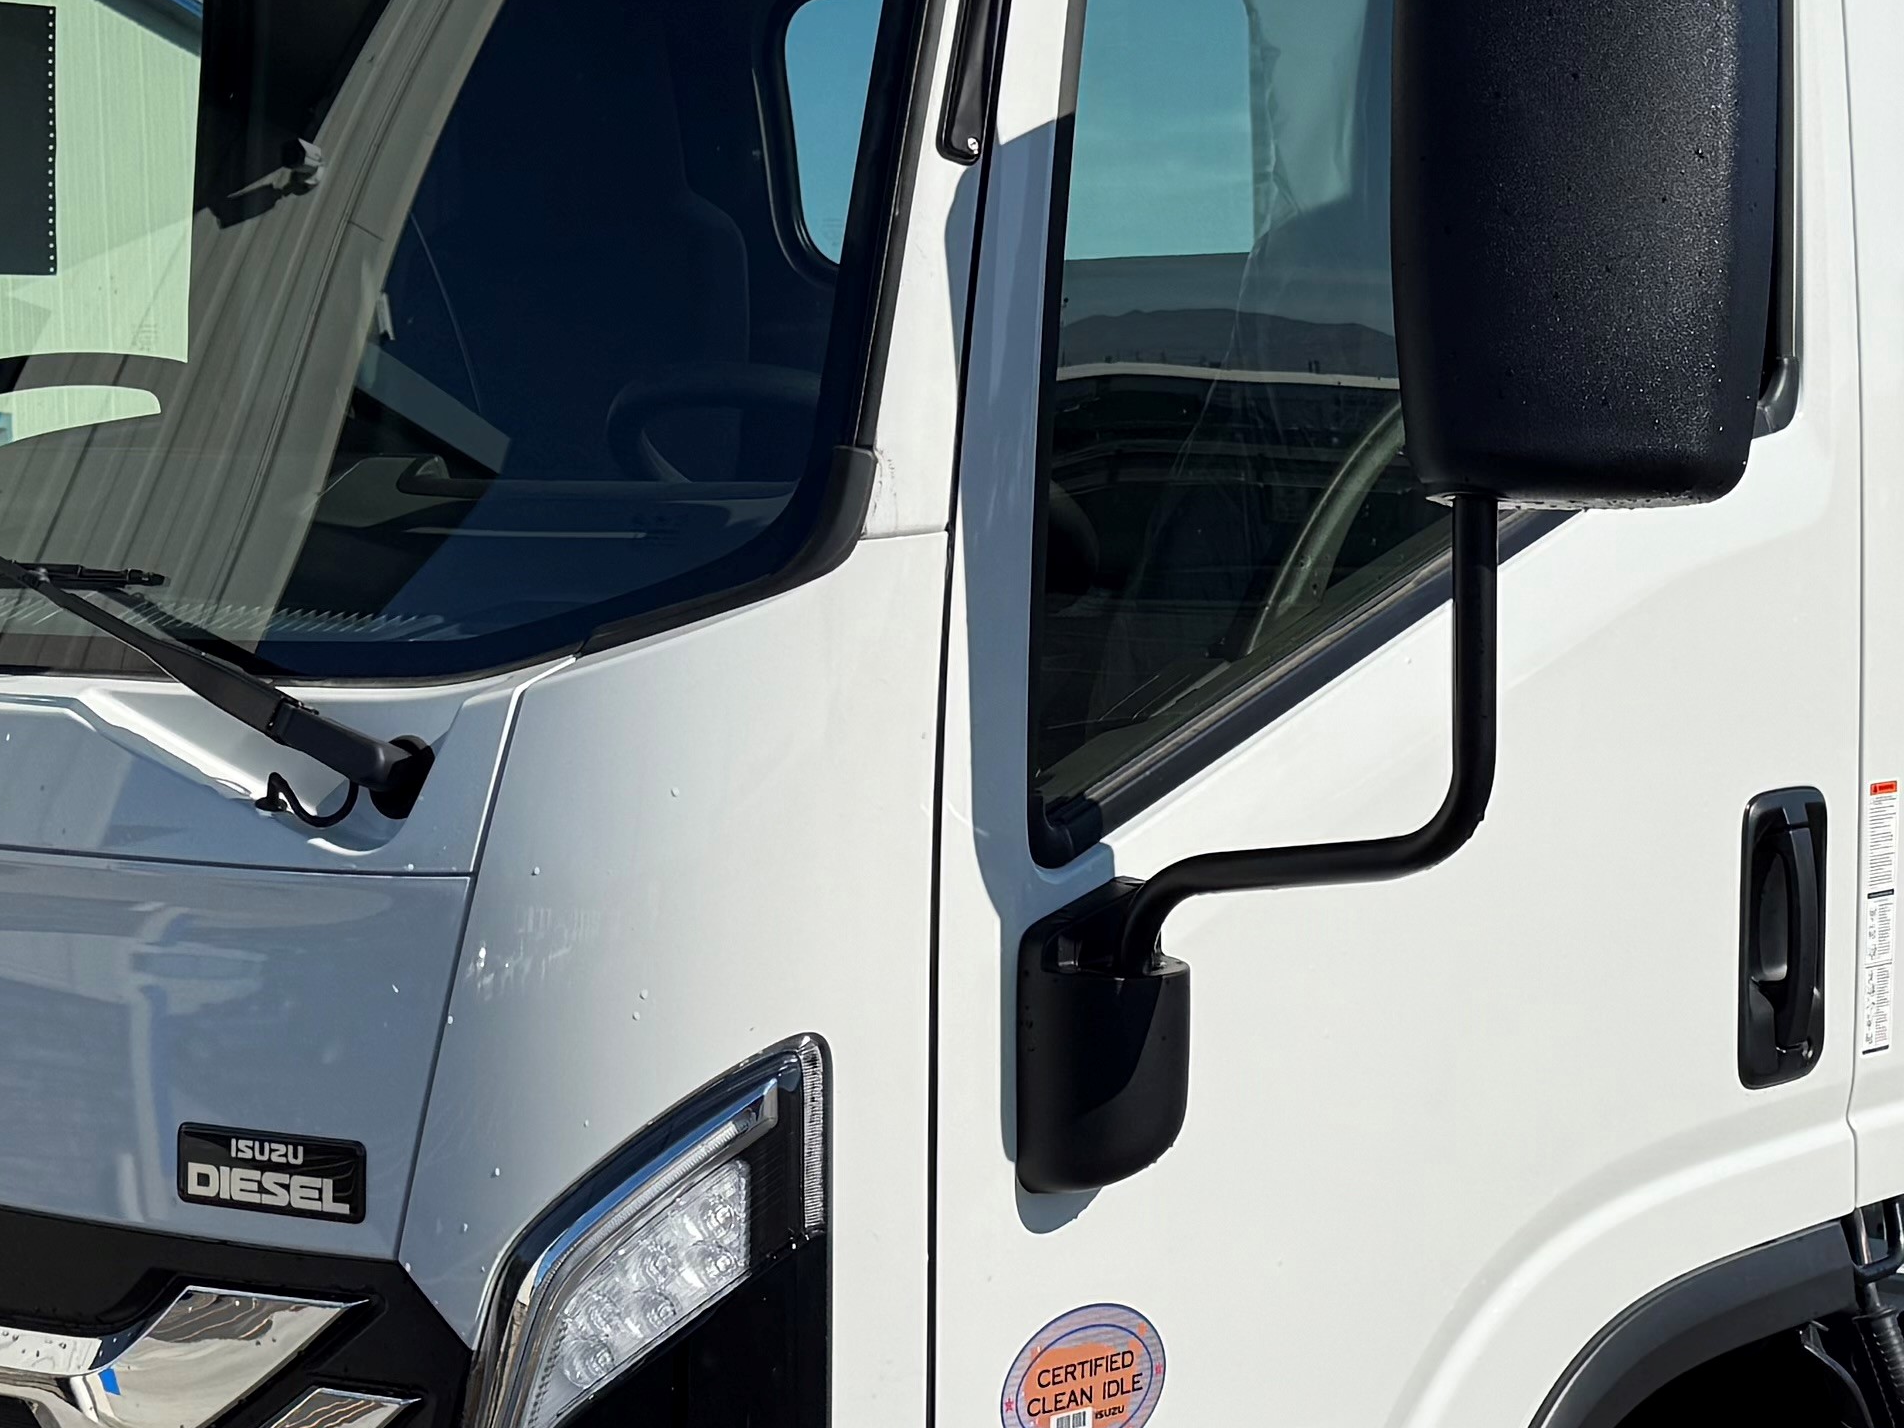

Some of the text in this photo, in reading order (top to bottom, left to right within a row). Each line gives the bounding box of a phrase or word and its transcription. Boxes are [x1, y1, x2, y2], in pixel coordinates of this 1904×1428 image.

[230, 1138, 304, 1165] ISUZU
[187, 1162, 350, 1215] DIESEL
[1037, 1349, 1134, 1389] CERTIFIED
[1027, 1373, 1143, 1417] CLEAN IDLE
